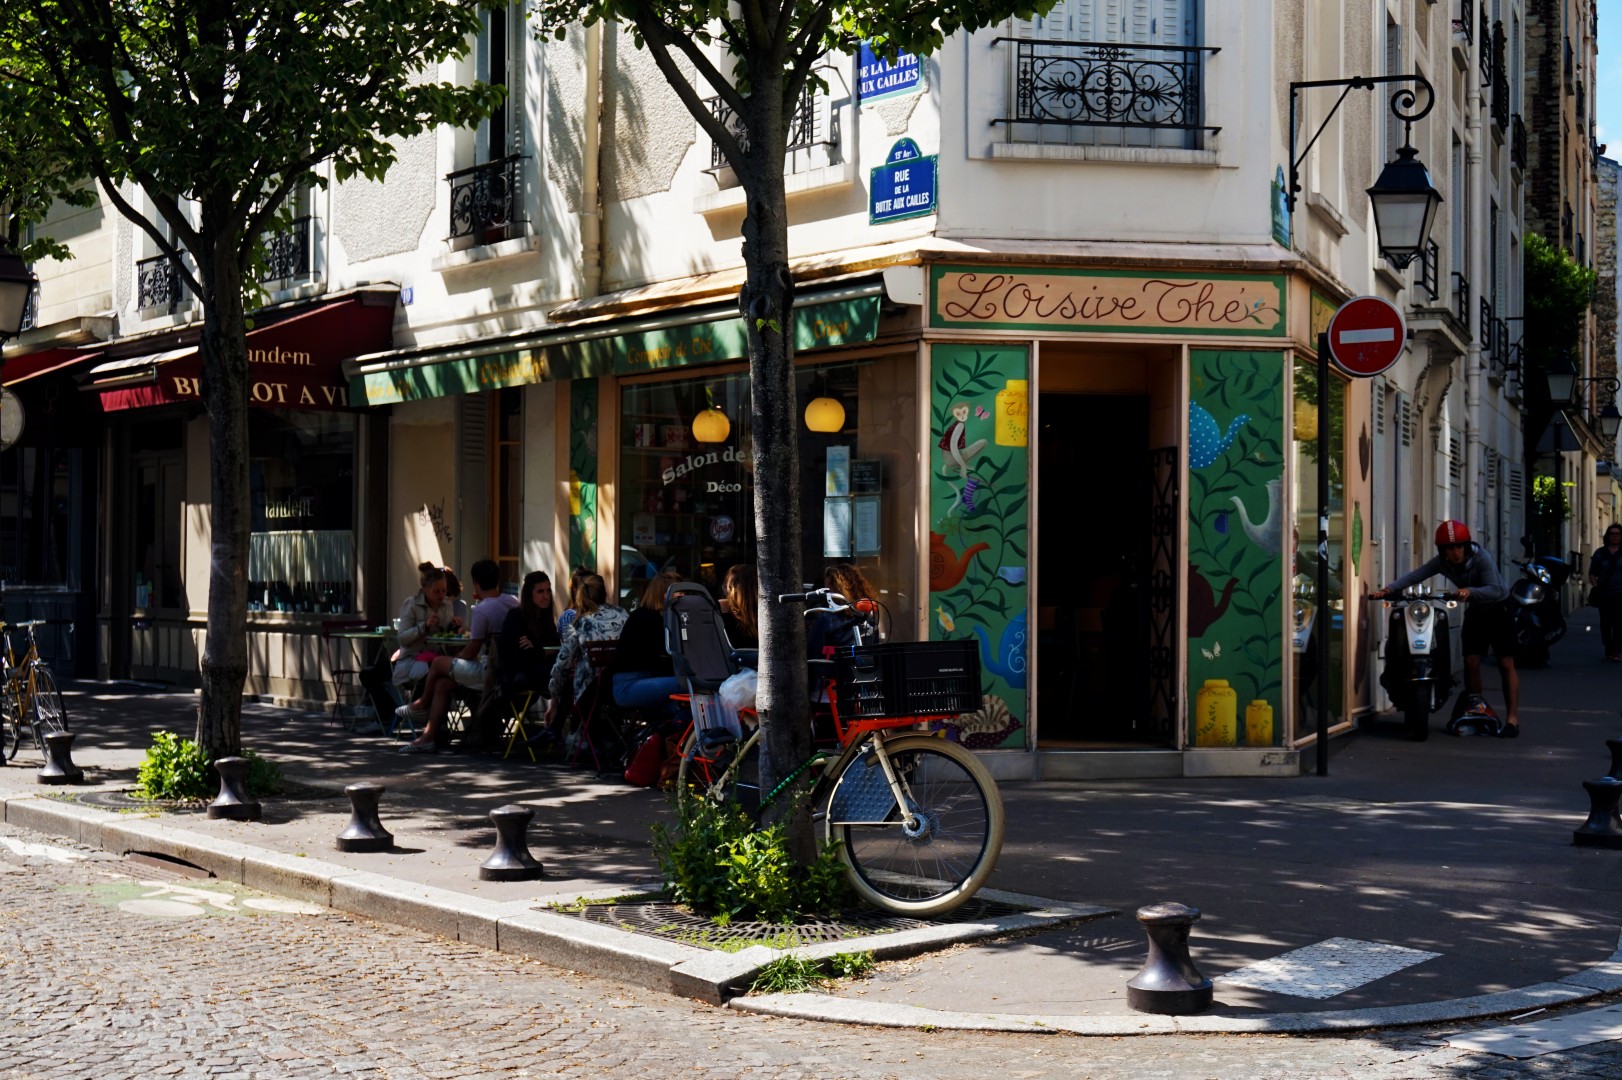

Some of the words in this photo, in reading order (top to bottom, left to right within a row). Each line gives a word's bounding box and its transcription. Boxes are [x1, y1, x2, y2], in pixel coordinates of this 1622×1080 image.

[871, 62, 884, 76] LA
[877, 68, 918, 90] CAILLES
[894, 169, 910, 183] RUE
[894, 186, 902, 195] DE
[903, 184, 909, 193] LA
[875, 199, 892, 214] BUTTE
[893, 196, 905, 210] AUX
[906, 192, 930, 208] CAILLES
[945, 272, 1146, 320] L'Oisive
[1142, 279, 1250, 323] Thé
[247, 346, 316, 366] andem
[299, 384, 316, 405] A
[320, 385, 350, 407] VI
[661, 451, 719, 486] Salon
[722, 445, 746, 463] de
[706, 480, 742, 493] Déco
